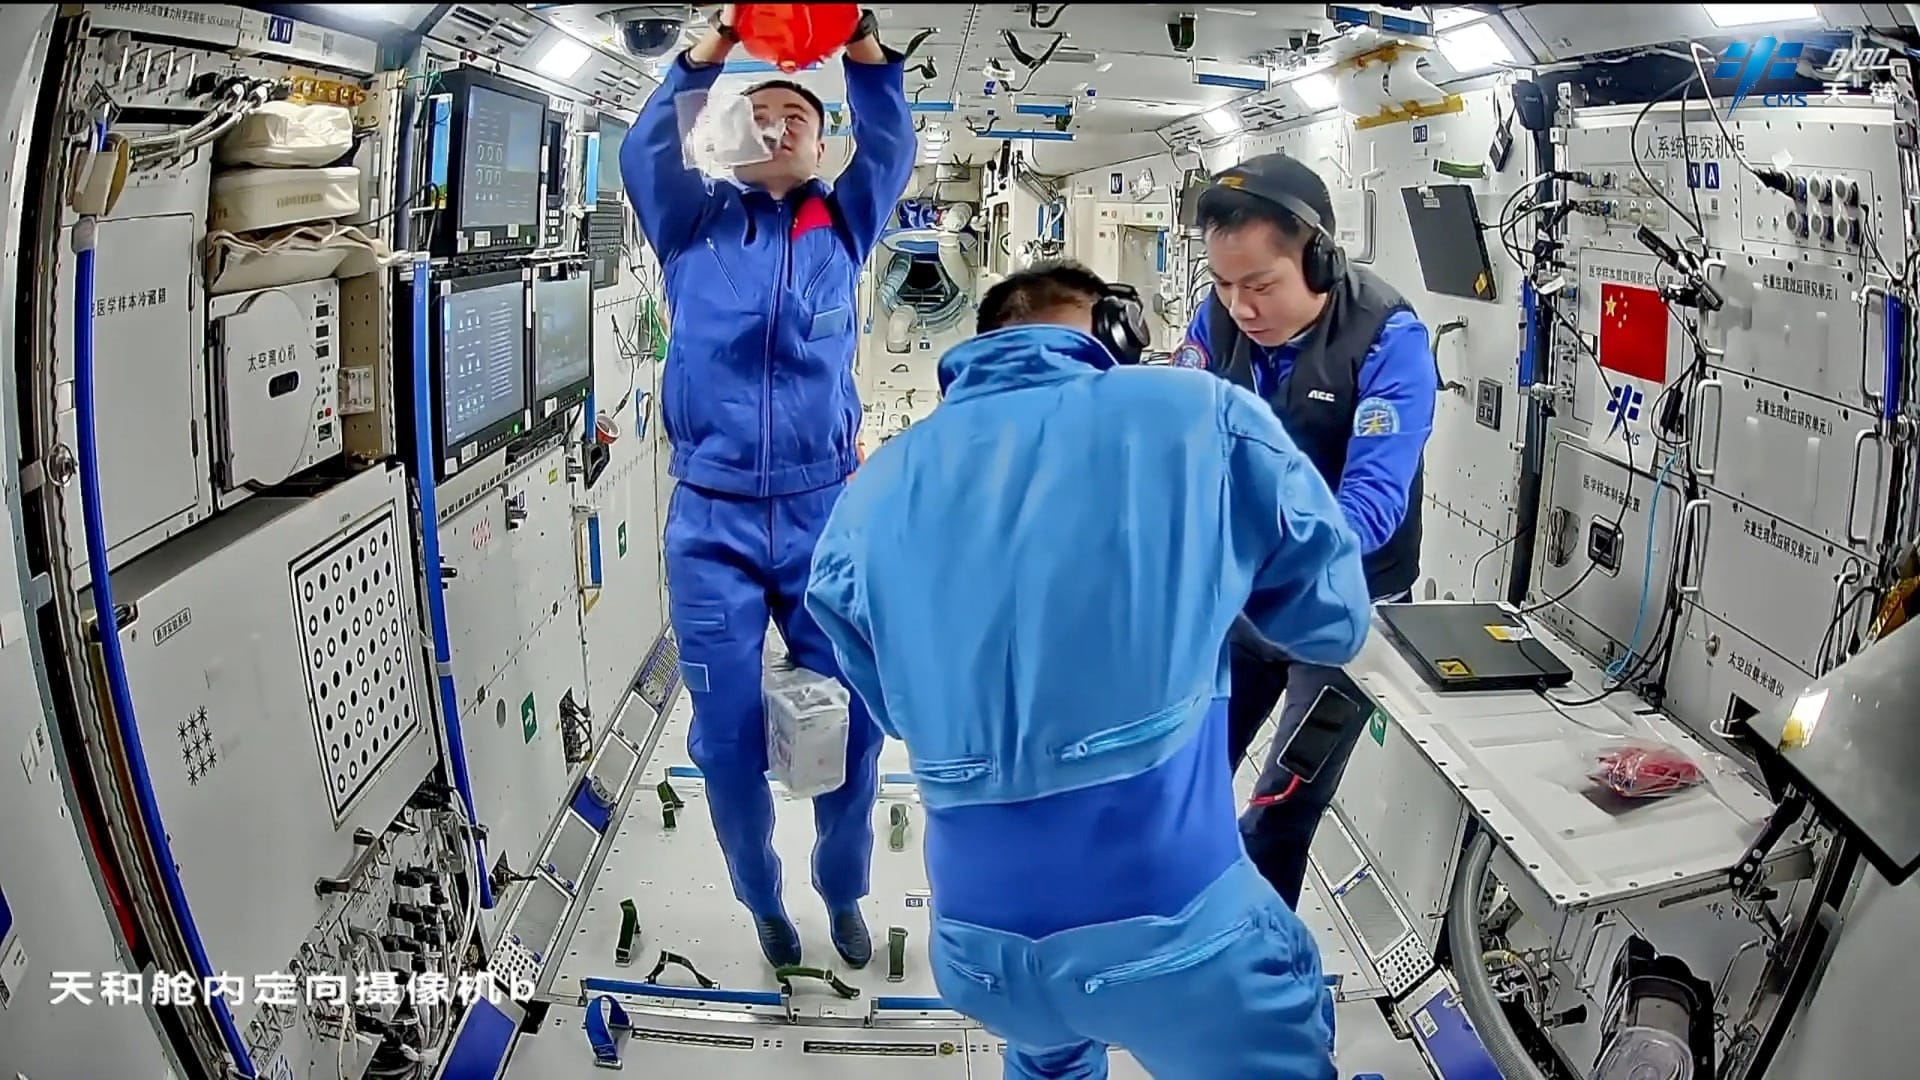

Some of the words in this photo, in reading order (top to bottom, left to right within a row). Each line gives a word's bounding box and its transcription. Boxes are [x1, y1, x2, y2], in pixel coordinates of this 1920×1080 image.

[1643, 134, 1746, 160] 人系统研究机柜
[247, 344, 296, 373] 太空离心机
